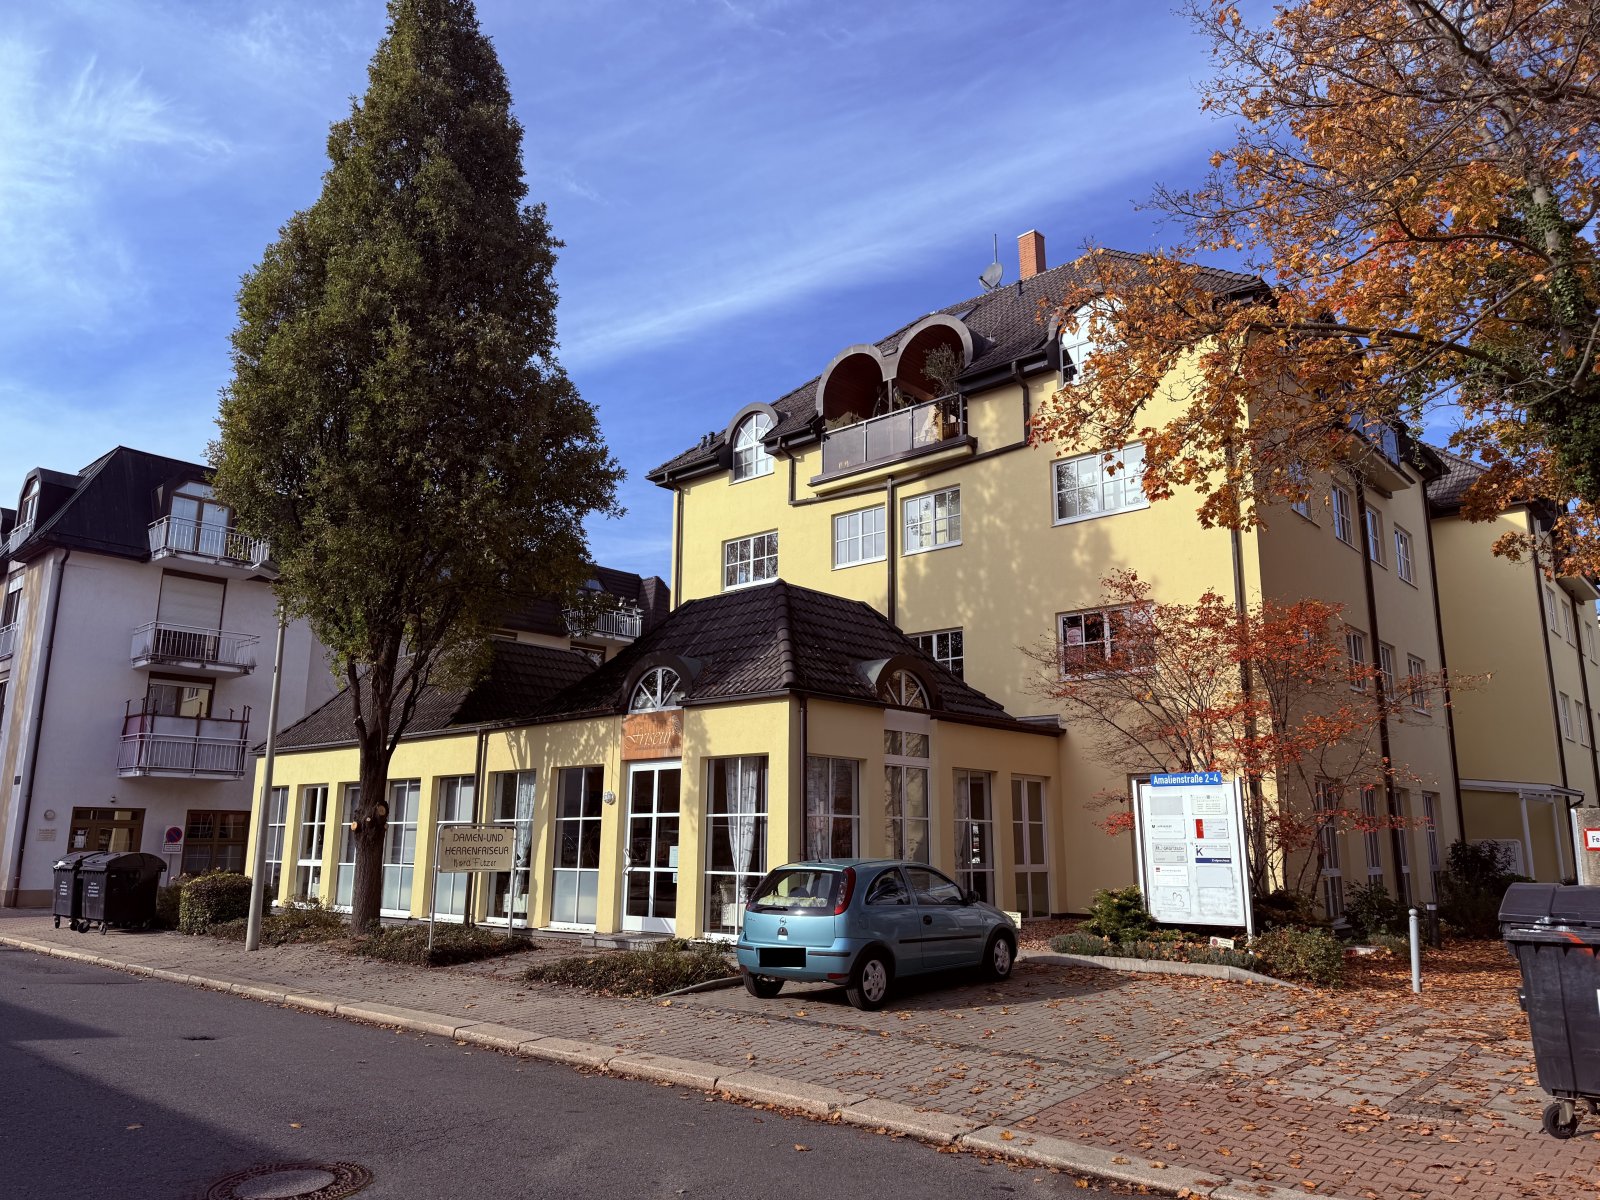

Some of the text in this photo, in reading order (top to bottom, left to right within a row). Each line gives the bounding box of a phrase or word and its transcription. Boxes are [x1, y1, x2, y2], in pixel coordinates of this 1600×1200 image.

[624, 730, 674, 749] Friseur
[1153, 773, 1219, 785] Amalienstraße 2-4
[445, 846, 509, 855] HERRENFRISEUR
